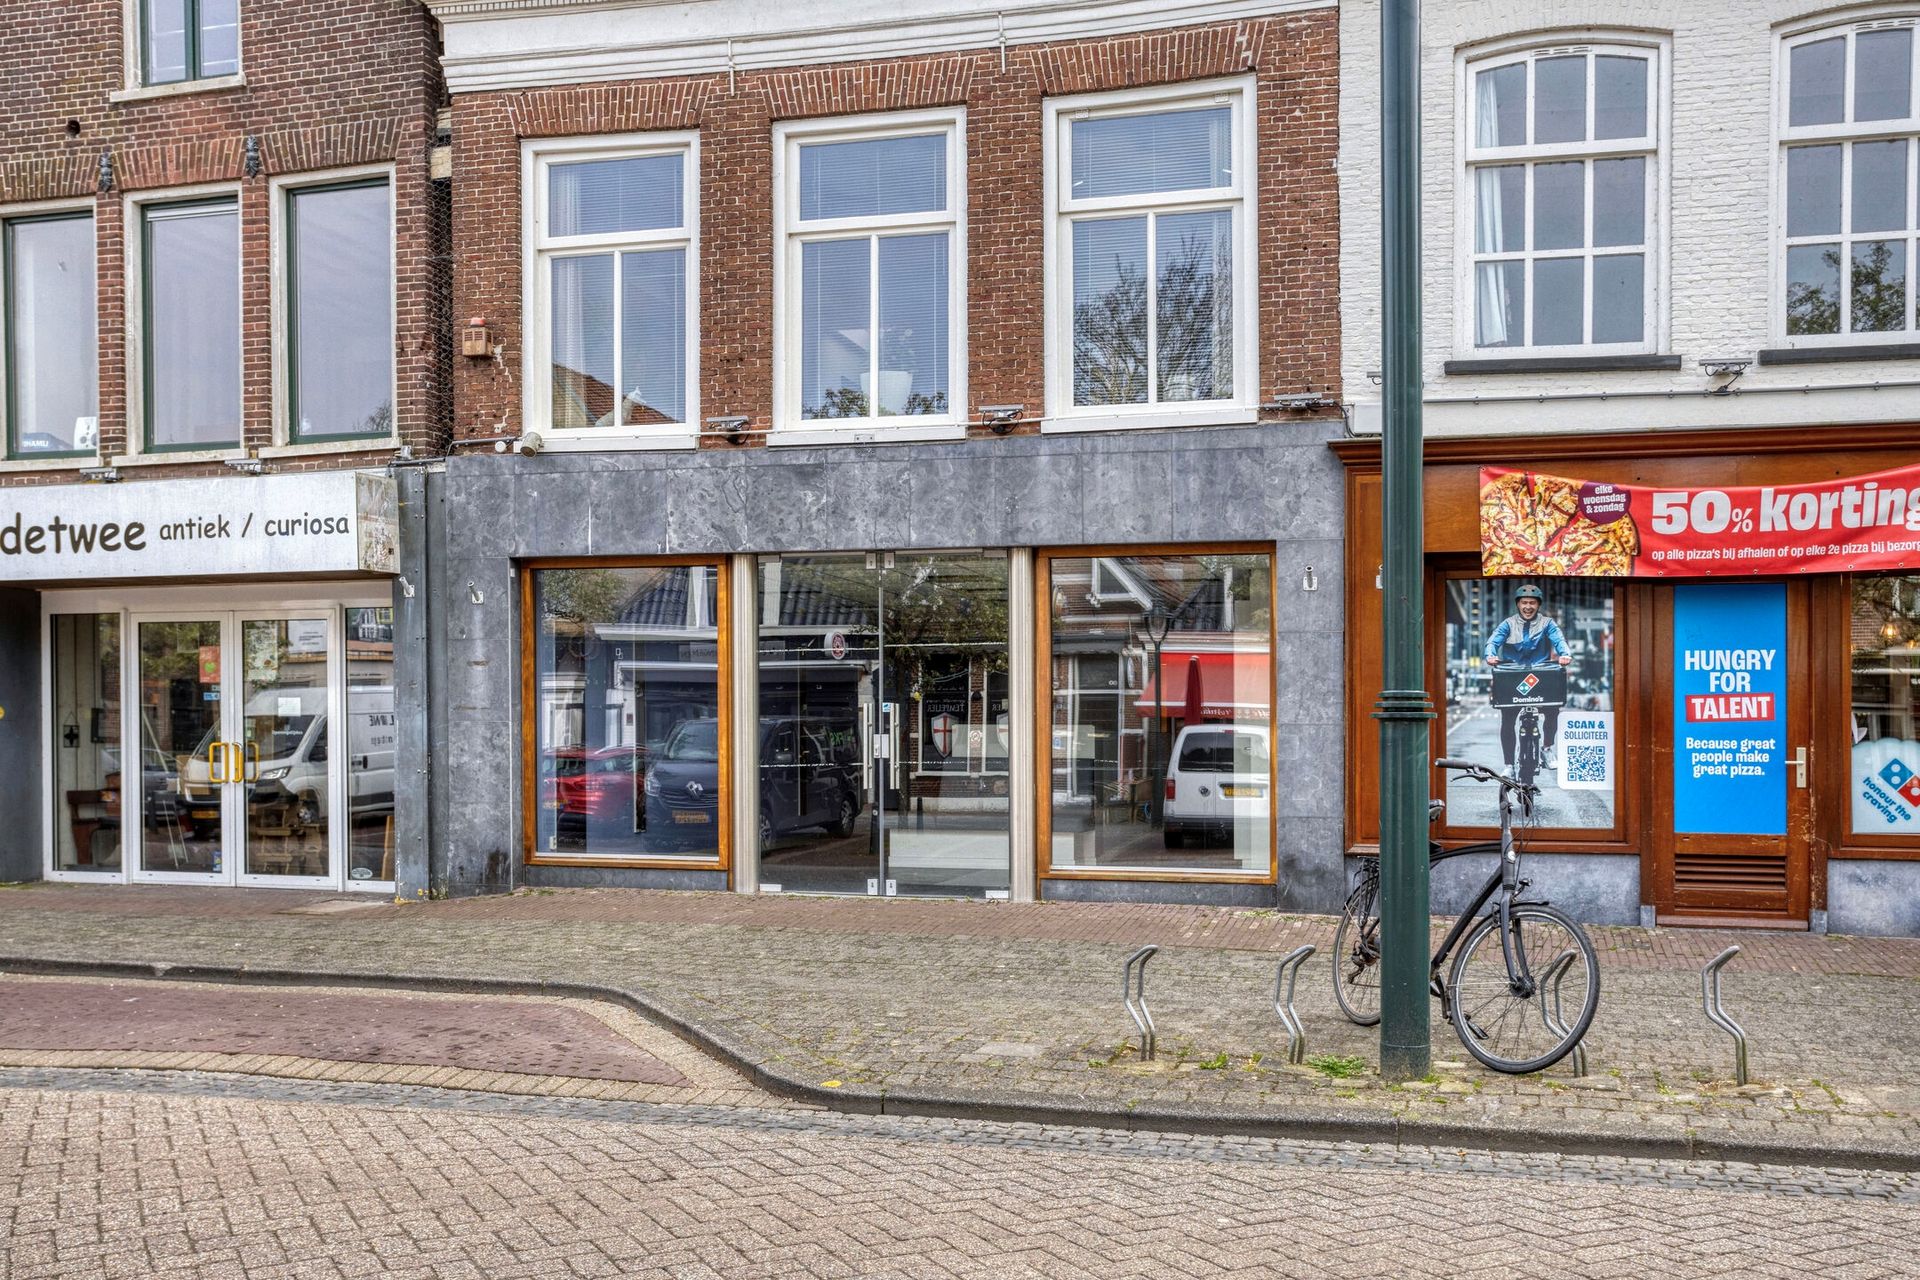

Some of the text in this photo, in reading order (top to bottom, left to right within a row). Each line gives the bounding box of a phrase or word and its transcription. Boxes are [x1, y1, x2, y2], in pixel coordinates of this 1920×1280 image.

[1594, 485, 1613, 495] elke
[1583, 493, 1626, 505] woensdag
[1586, 503, 1625, 513] & zondag
[1651, 490, 1753, 535] 50%
[0, 512, 350, 555] detwee antiek / curiosa
[1652, 550, 1665, 561] op
[1667, 548, 1684, 560] alle
[1687, 548, 1721, 560] pizza's
[1723, 547, 1735, 560] bij
[1738, 547, 1776, 558] afhalen
[1777, 545, 1790, 557] of
[1791, 547, 1804, 558] op
[1806, 544, 1826, 556] elke
[1828, 543, 1840, 554] 2e
[1842, 543, 1869, 555] pizza
[1871, 541, 1885, 554] bij
[1684, 649, 1776, 671] HUNGRY
[1709, 671, 1751, 692] FOR
[1512, 696, 1544, 704] Domino's
[1691, 696, 1771, 719] TALENT
[1567, 720, 1605, 729] SCAN &
[1564, 731, 1608, 740] SOLLICITEER
[1685, 737, 1776, 752] Because great
[1691, 750, 1770, 765] people make
[1693, 763, 1765, 778] great pizza.
[1863, 777, 1911, 820] honour the
[1863, 791, 1897, 823] craving
